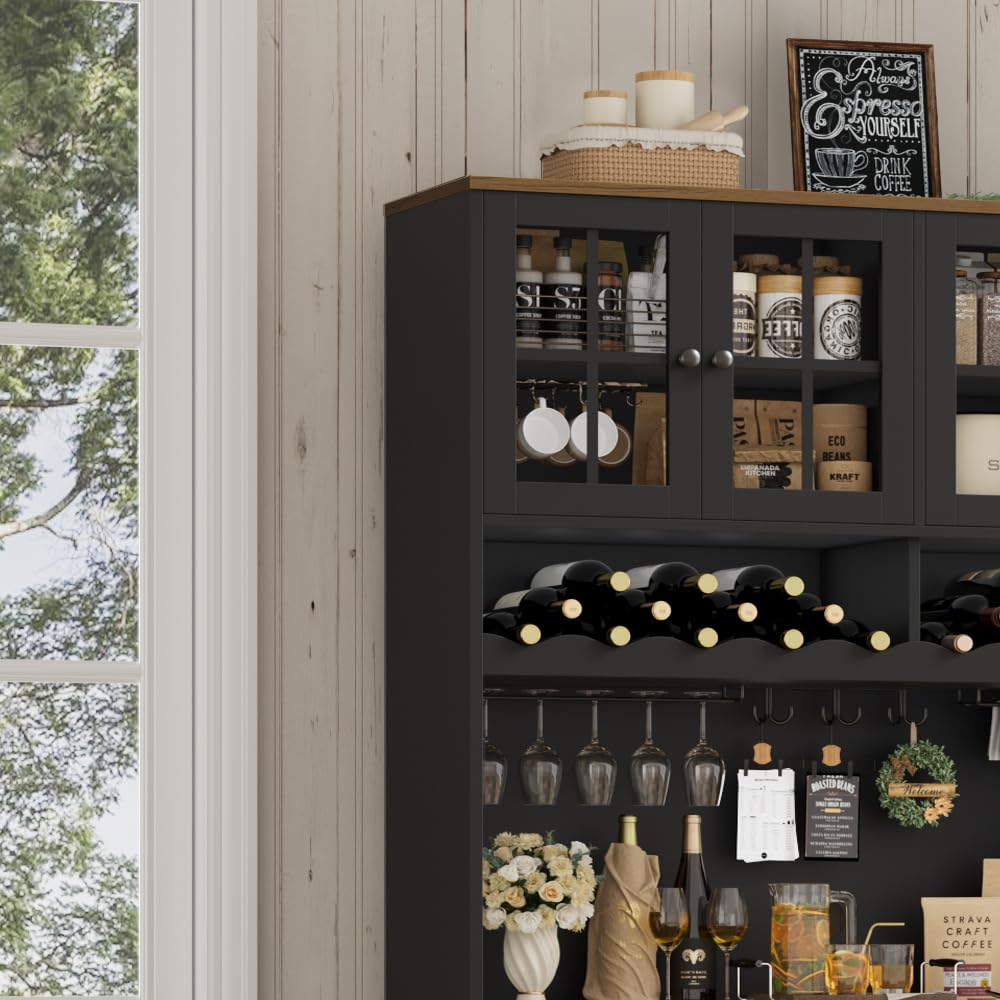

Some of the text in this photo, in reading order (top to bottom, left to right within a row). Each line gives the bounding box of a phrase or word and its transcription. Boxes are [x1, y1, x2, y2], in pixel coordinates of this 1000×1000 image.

[846, 56, 912, 86] Always
[801, 67, 923, 139] Espresso
[857, 115, 921, 140] YOURSELF
[874, 157, 911, 175] DRINK
[874, 174, 912, 192] COFFEE
[828, 435, 846, 447] ECO
[822, 452, 852, 462] BEANS
[829, 473, 860, 481] KRAFT
[810, 779, 856, 794] ROASTED BEANS
[903, 785, 942, 796] Welcome
[943, 915, 991, 924] STRAVA
[946, 927, 988, 936] CRAFT
[942, 940, 992, 949] COFFEE
